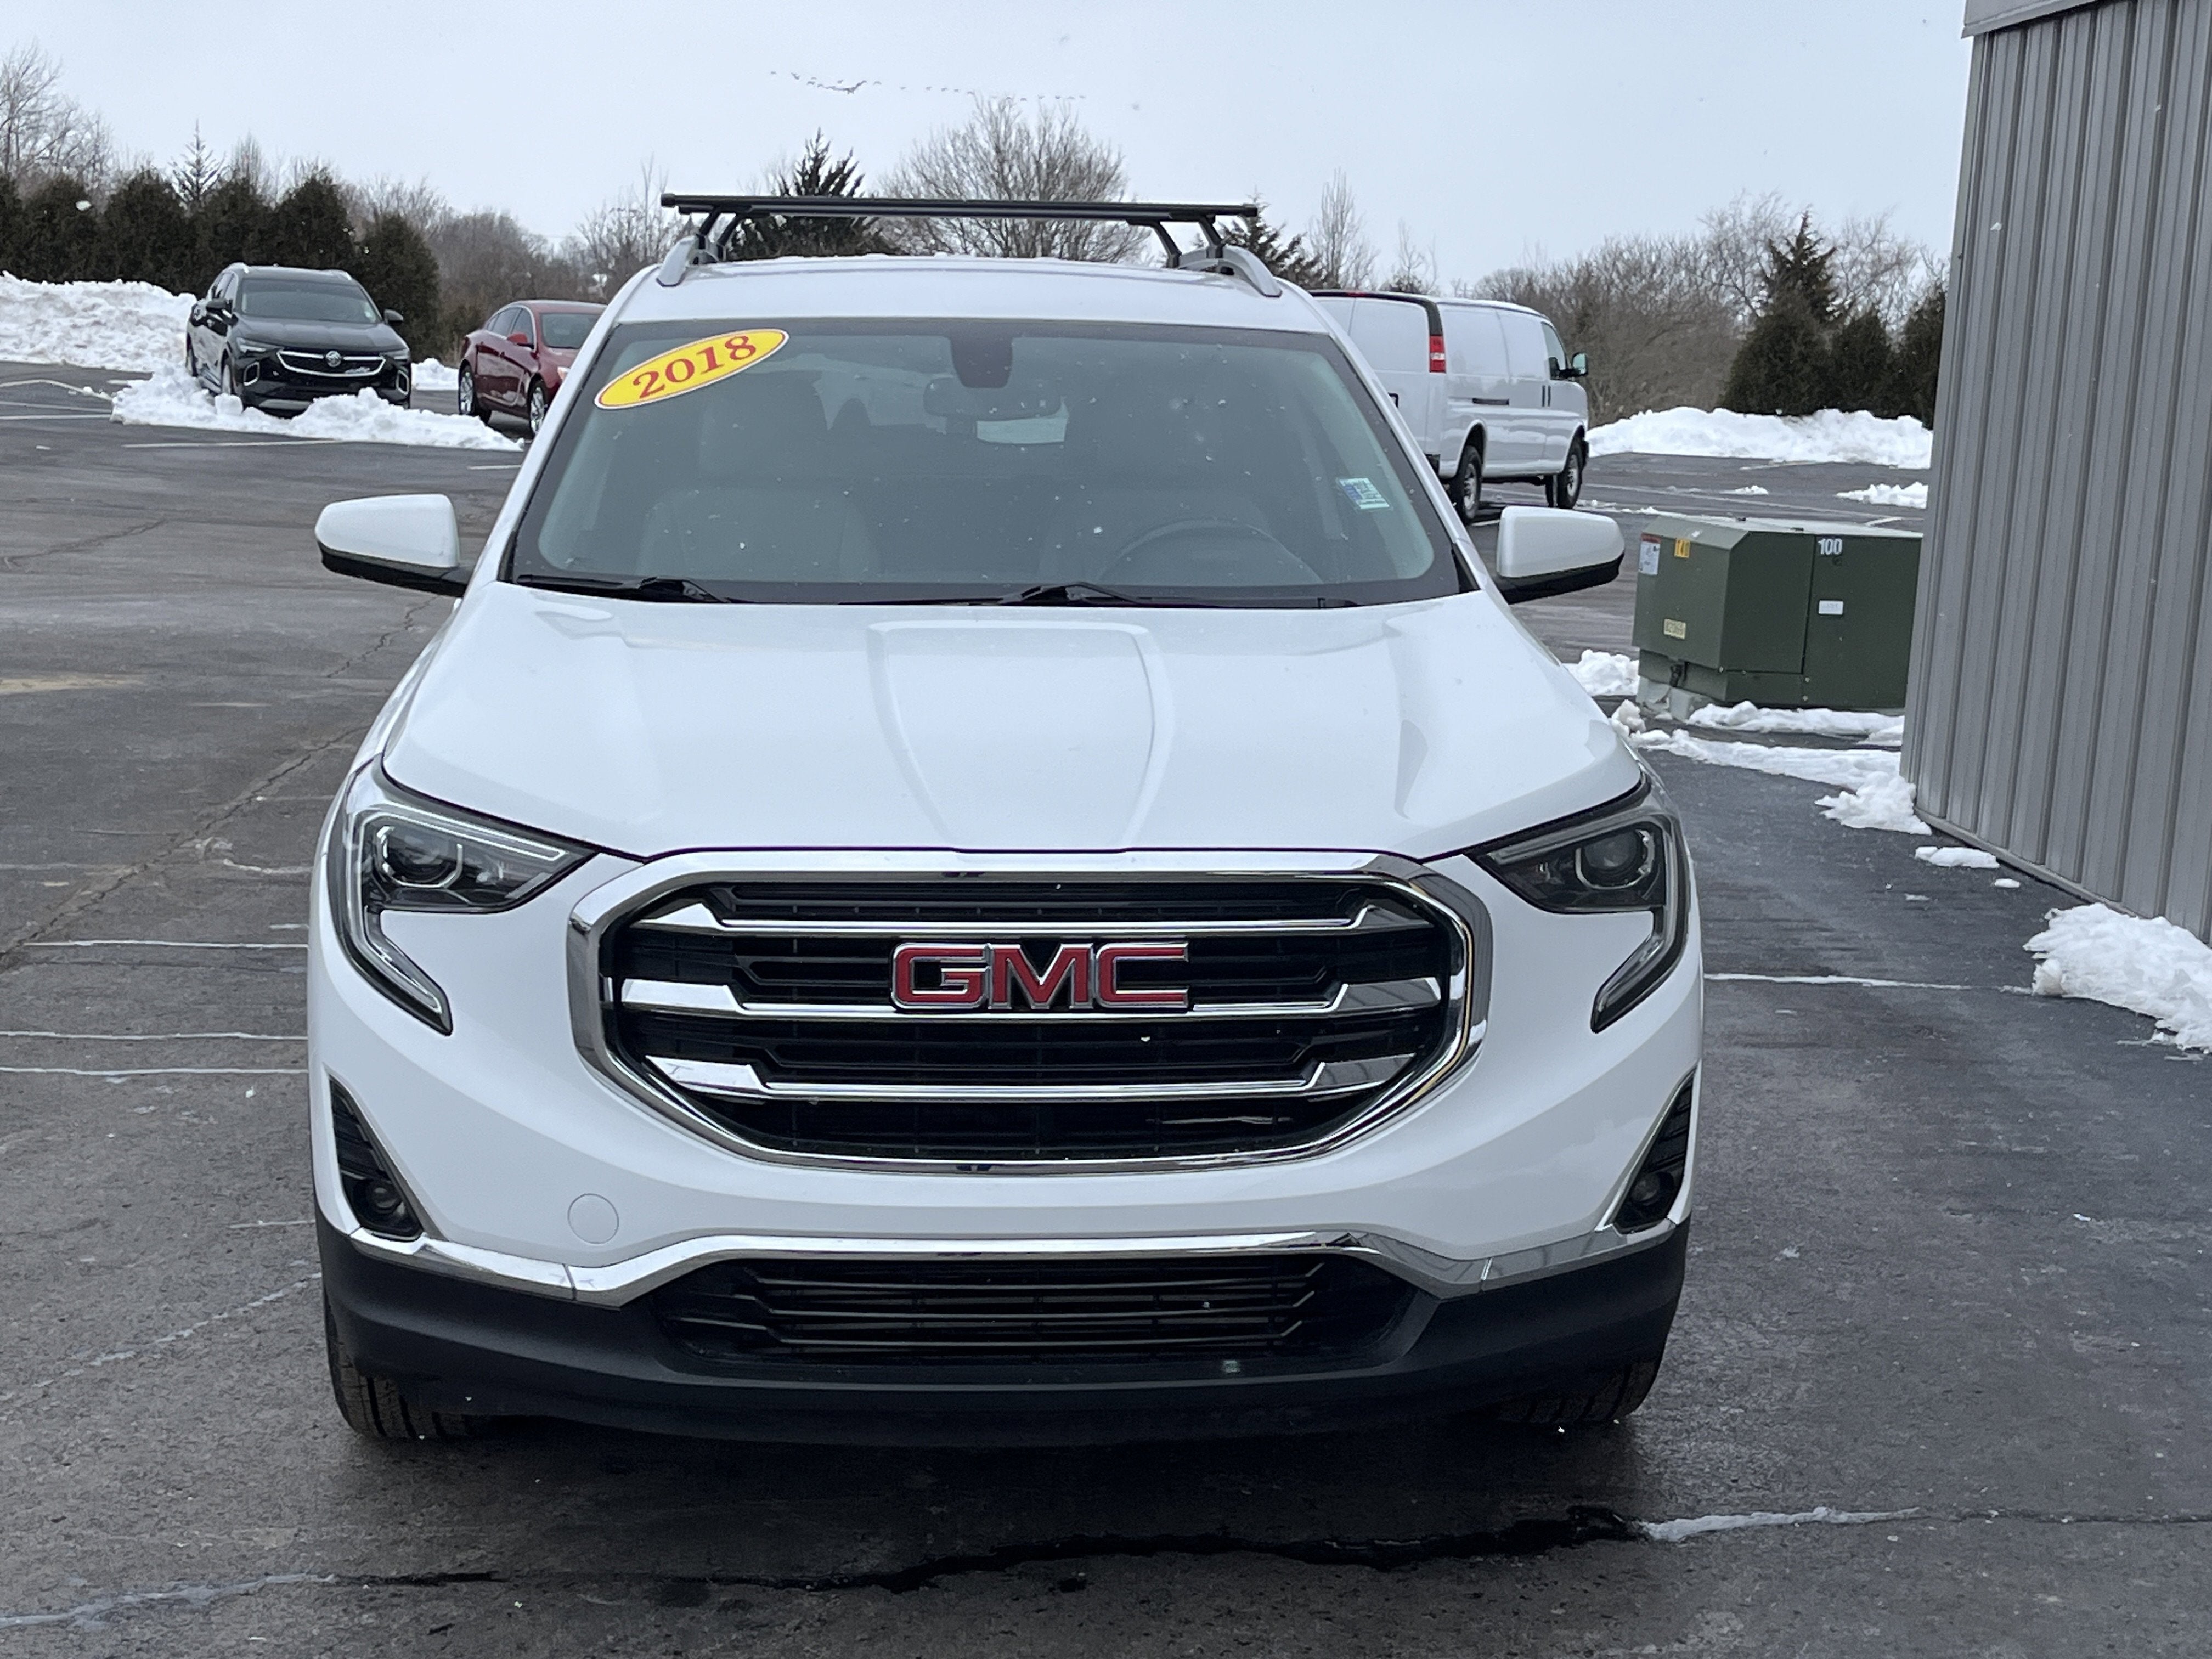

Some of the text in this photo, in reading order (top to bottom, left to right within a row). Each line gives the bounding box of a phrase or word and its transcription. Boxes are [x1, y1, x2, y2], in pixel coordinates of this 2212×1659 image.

[633, 335, 757, 399] 2018
[1818, 538, 1842, 555] 100
[891, 941, 1189, 1011] GMC
